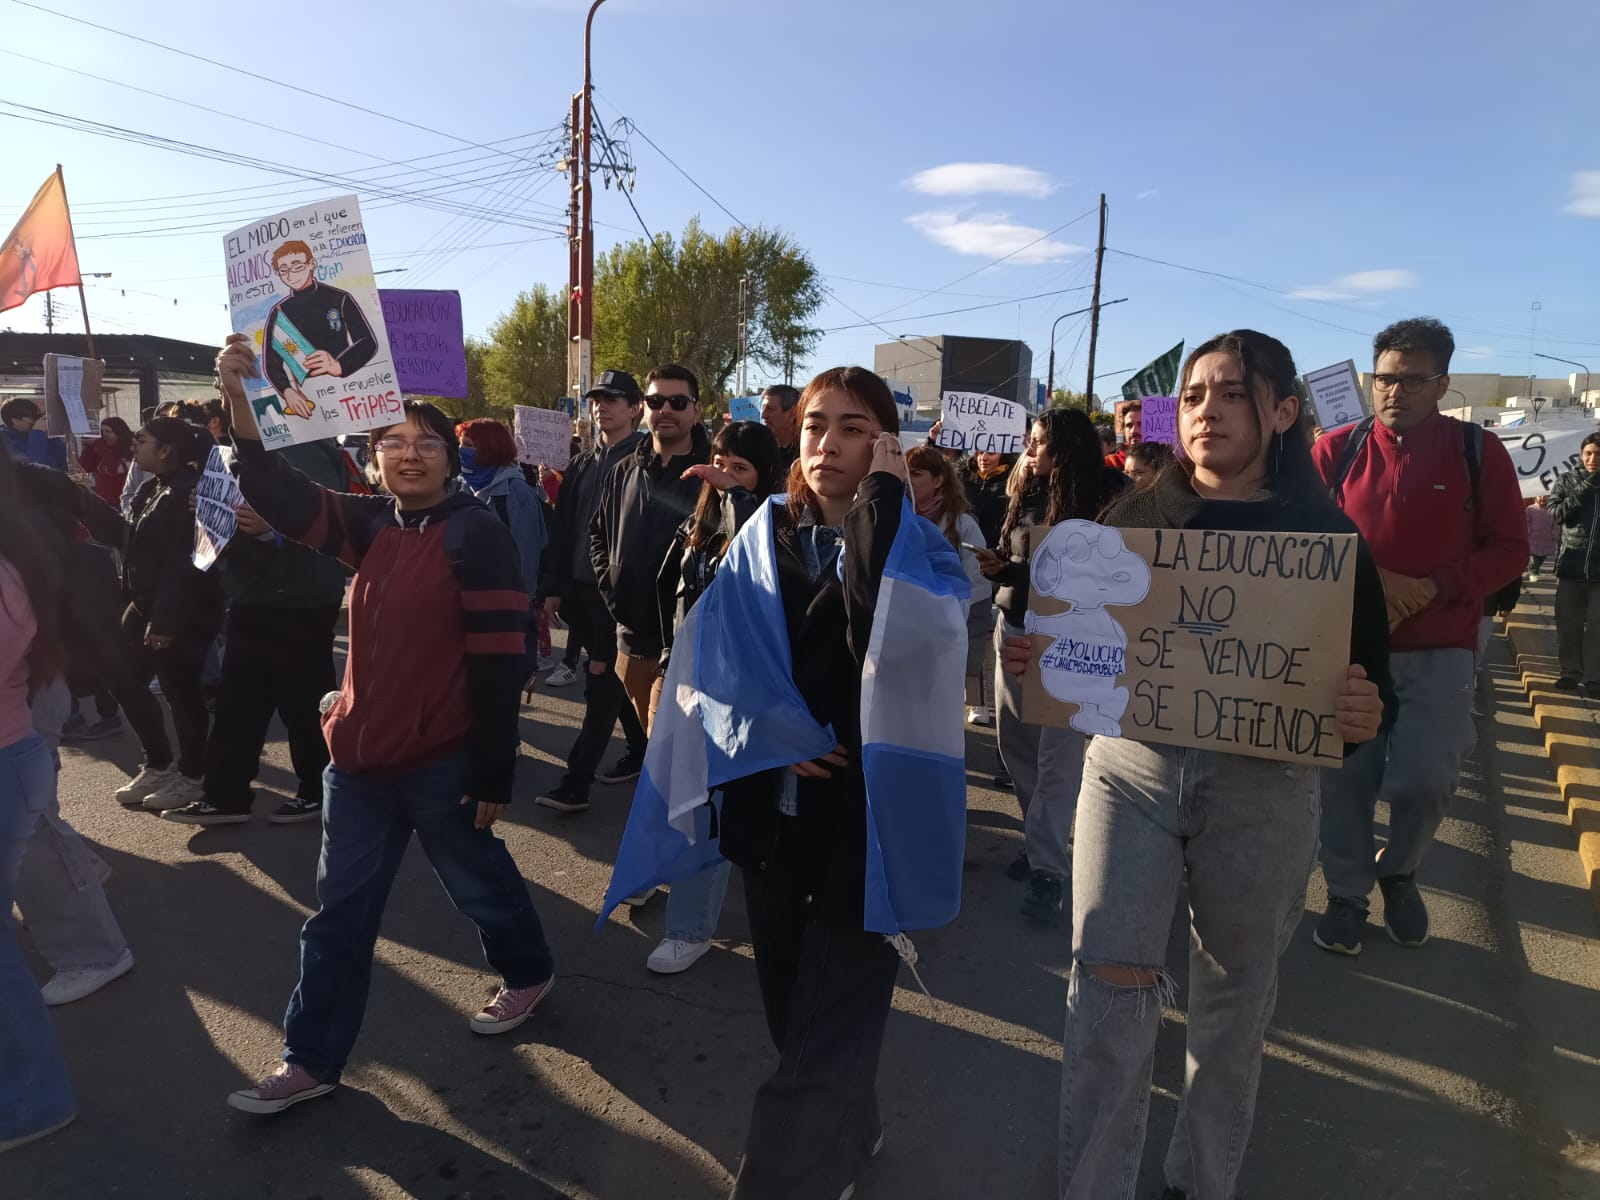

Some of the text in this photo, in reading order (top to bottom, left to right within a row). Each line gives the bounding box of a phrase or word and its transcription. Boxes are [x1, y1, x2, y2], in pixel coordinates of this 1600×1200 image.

[228, 208, 348, 259] EL MODO en el que
[309, 221, 363, 241] se refieren
[228, 250, 272, 289] ALGUNOS
[231, 293, 243, 307] en
[316, 372, 393, 399] me revuelve
[320, 406, 339, 422] las
[1143, 398, 1177, 416] CUAN
[262, 423, 290, 438] UNPA
[976, 419, 988, 432] &
[1152, 530, 1189, 571] LA
[1178, 585, 1236, 623] NO
[1136, 627, 1310, 687] SE VENDE
[1132, 679, 1174, 731] SE
